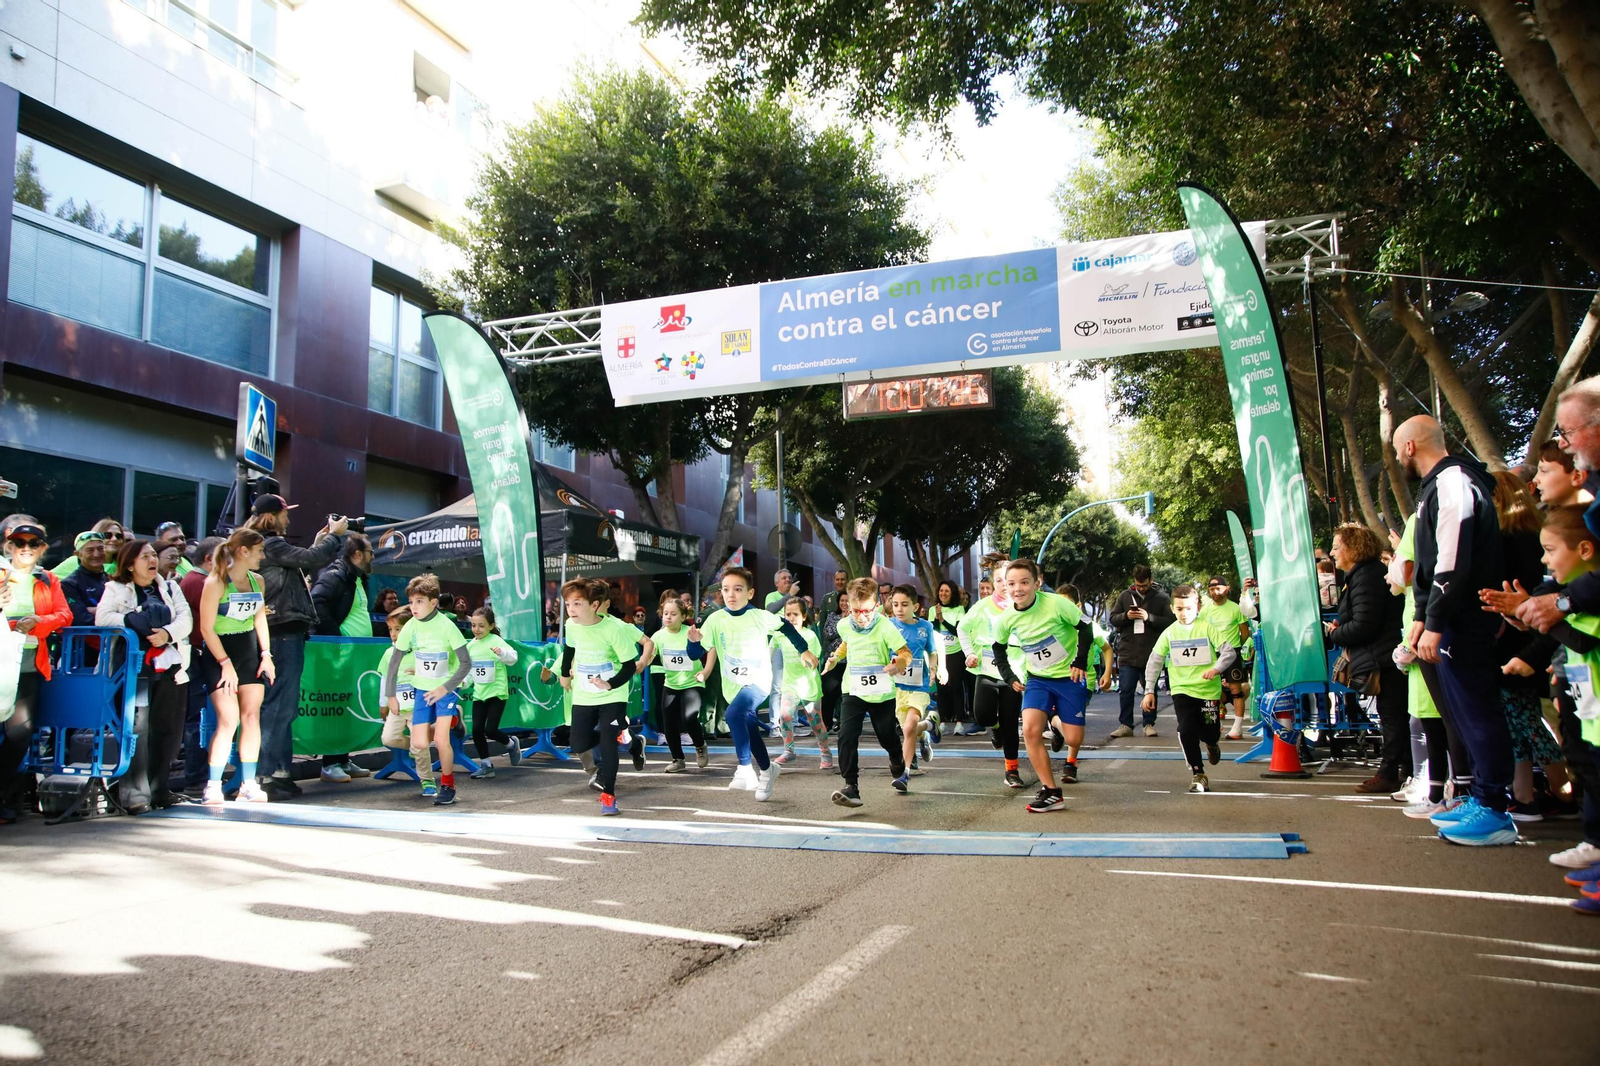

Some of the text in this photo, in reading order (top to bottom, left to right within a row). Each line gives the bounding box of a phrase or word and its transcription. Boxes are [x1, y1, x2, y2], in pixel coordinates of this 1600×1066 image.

[1094, 252, 1153, 269] cajamar
[778, 263, 1038, 313] Almería en marcha
[1098, 294, 1138, 303] MICHELIN
[778, 300, 1002, 342] contra el cáncer
[1102, 317, 1132, 326] Toyota
[990, 326, 1052, 339] asociación española
[1102, 323, 1164, 335] Alborán Motor
[724, 332, 748, 343] SOLAN
[991, 334, 1040, 346] contra el cáncer
[1001, 342, 1026, 351] Almería
[608, 360, 643, 373] ALMERÍA
[772, 357, 857, 372] #TodosContraElCáncer
[408, 524, 481, 546] cruzandola
[237, 601, 257, 612] 731
[1033, 648, 1052, 661] 75
[1182, 647, 1198, 657] 47
[670, 656, 684, 664] 49
[423, 661, 438, 671] 57
[476, 667, 486, 676] 55
[731, 667, 748, 676] 42
[860, 675, 877, 686] 58
[308, 690, 353, 702] cáncer
[402, 690, 415, 701] 96
[320, 706, 344, 717] uno
